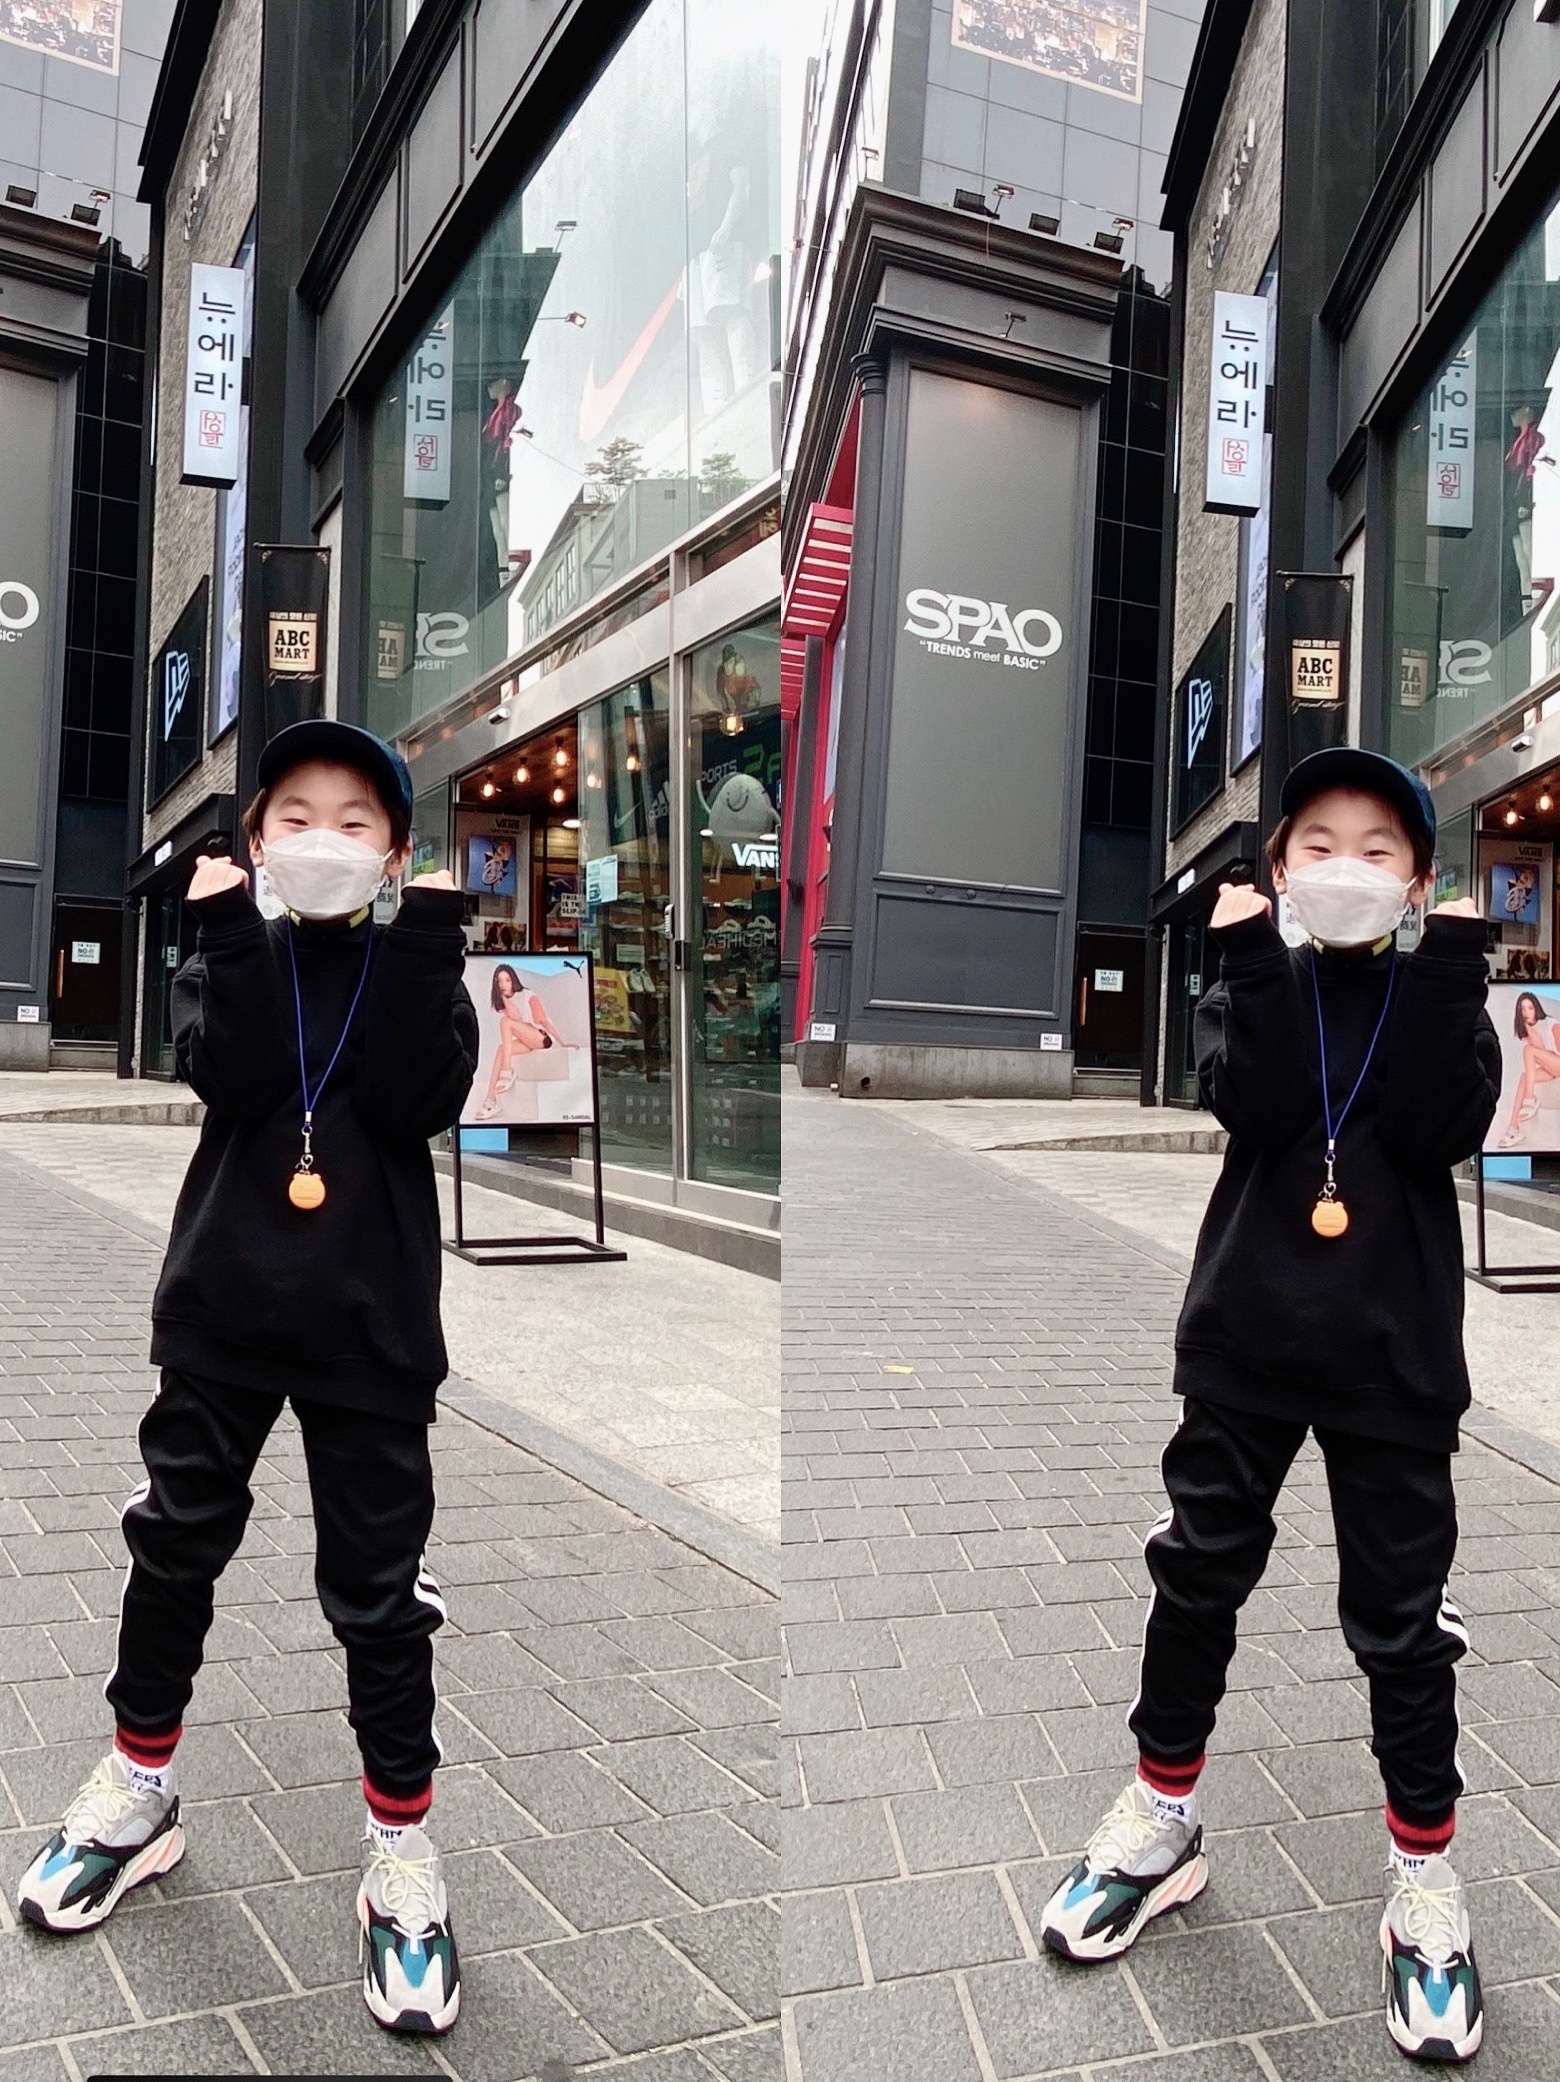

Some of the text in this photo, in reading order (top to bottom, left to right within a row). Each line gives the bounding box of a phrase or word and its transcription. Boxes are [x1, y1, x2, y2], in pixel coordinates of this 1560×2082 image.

[904, 589, 1062, 657] SPAO
[274, 630, 310, 646] ABC
[274, 647, 310, 659] MART
[973, 650, 1001, 662] meet
[1297, 657, 1333, 674] ABC
[1297, 675, 1333, 687] MART
[731, 842, 779, 868] VAN
